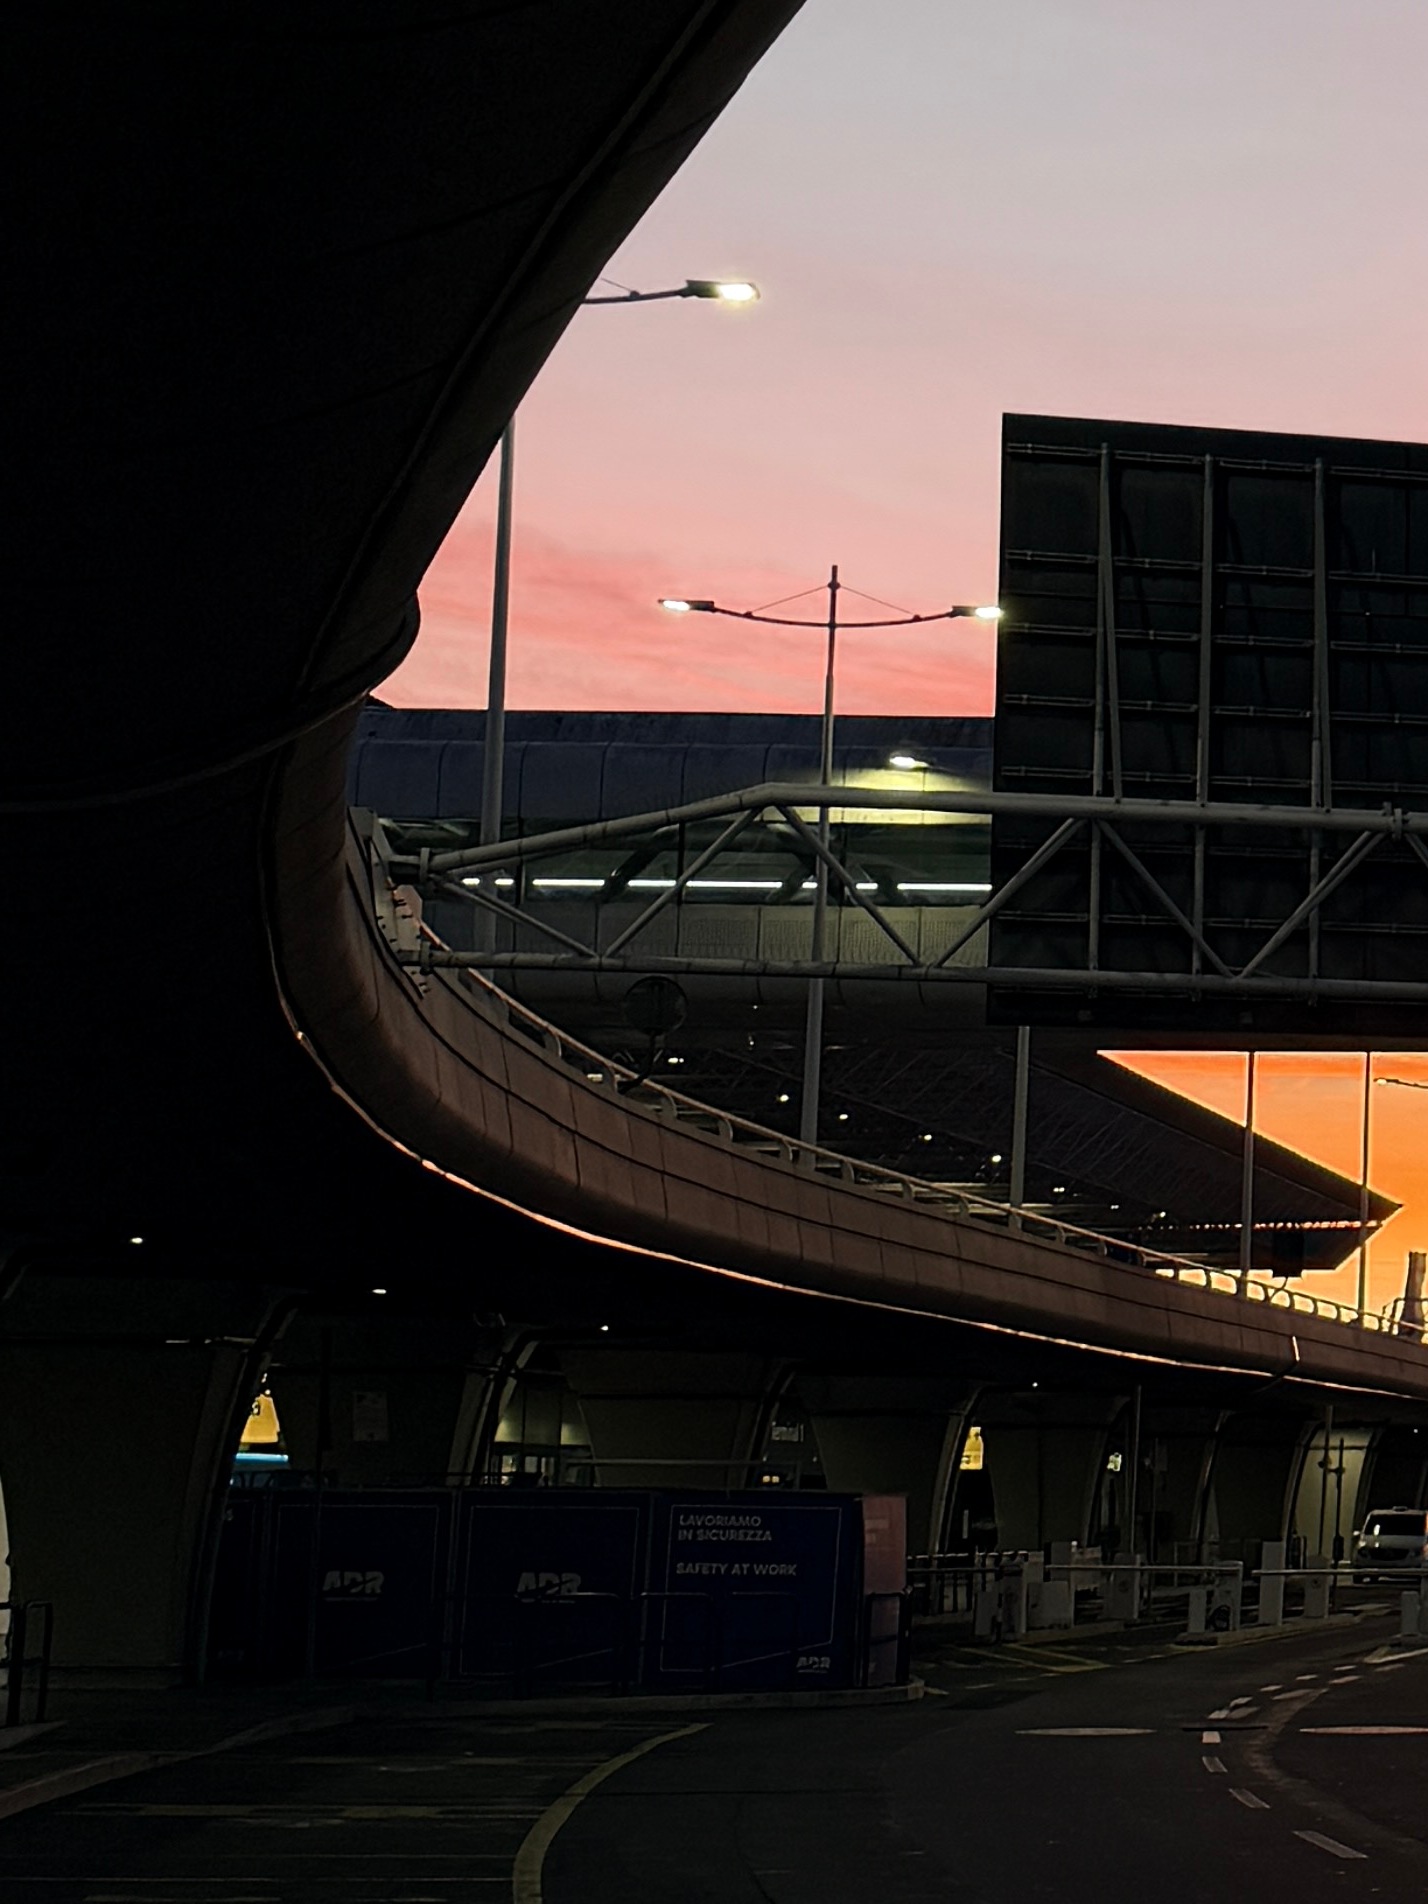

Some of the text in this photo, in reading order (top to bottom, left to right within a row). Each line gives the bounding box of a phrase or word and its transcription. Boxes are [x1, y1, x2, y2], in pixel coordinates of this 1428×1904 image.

[679, 1514, 762, 1527] LAVORIAMO
[678, 1529, 772, 1541] IN SICUREZZA
[675, 1561, 797, 1576] SAFETY AT WORK
[322, 1570, 384, 1594] ADR
[516, 1571, 582, 1596] ADR
